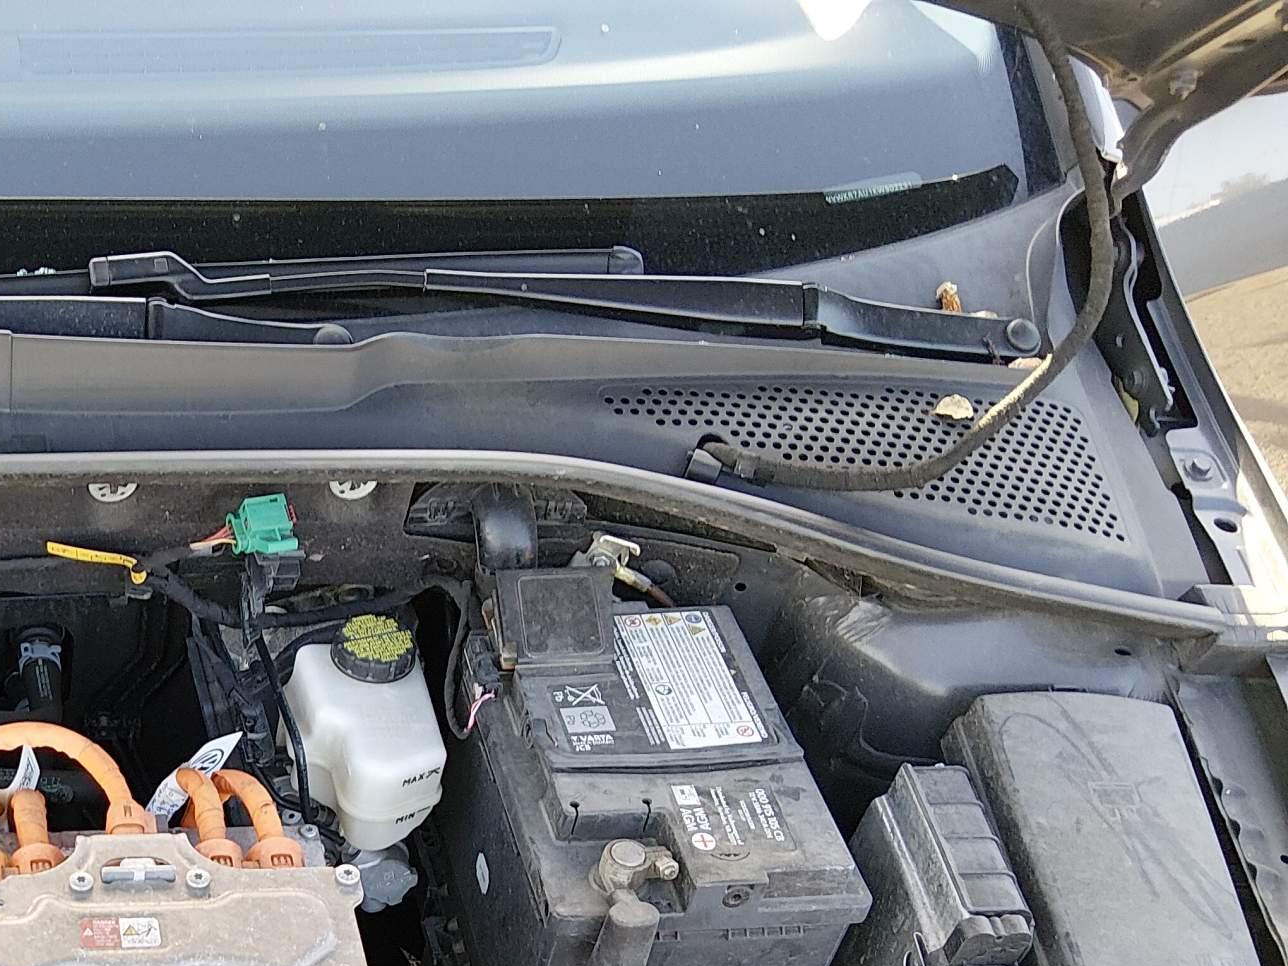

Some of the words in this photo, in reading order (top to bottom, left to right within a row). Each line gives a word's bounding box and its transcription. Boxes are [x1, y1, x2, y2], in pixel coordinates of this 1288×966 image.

[402, 772, 426, 787] MAX
[395, 811, 417, 825] MIN
[679, 807, 699, 832] AGM
[692, 806, 712, 831] AGM
